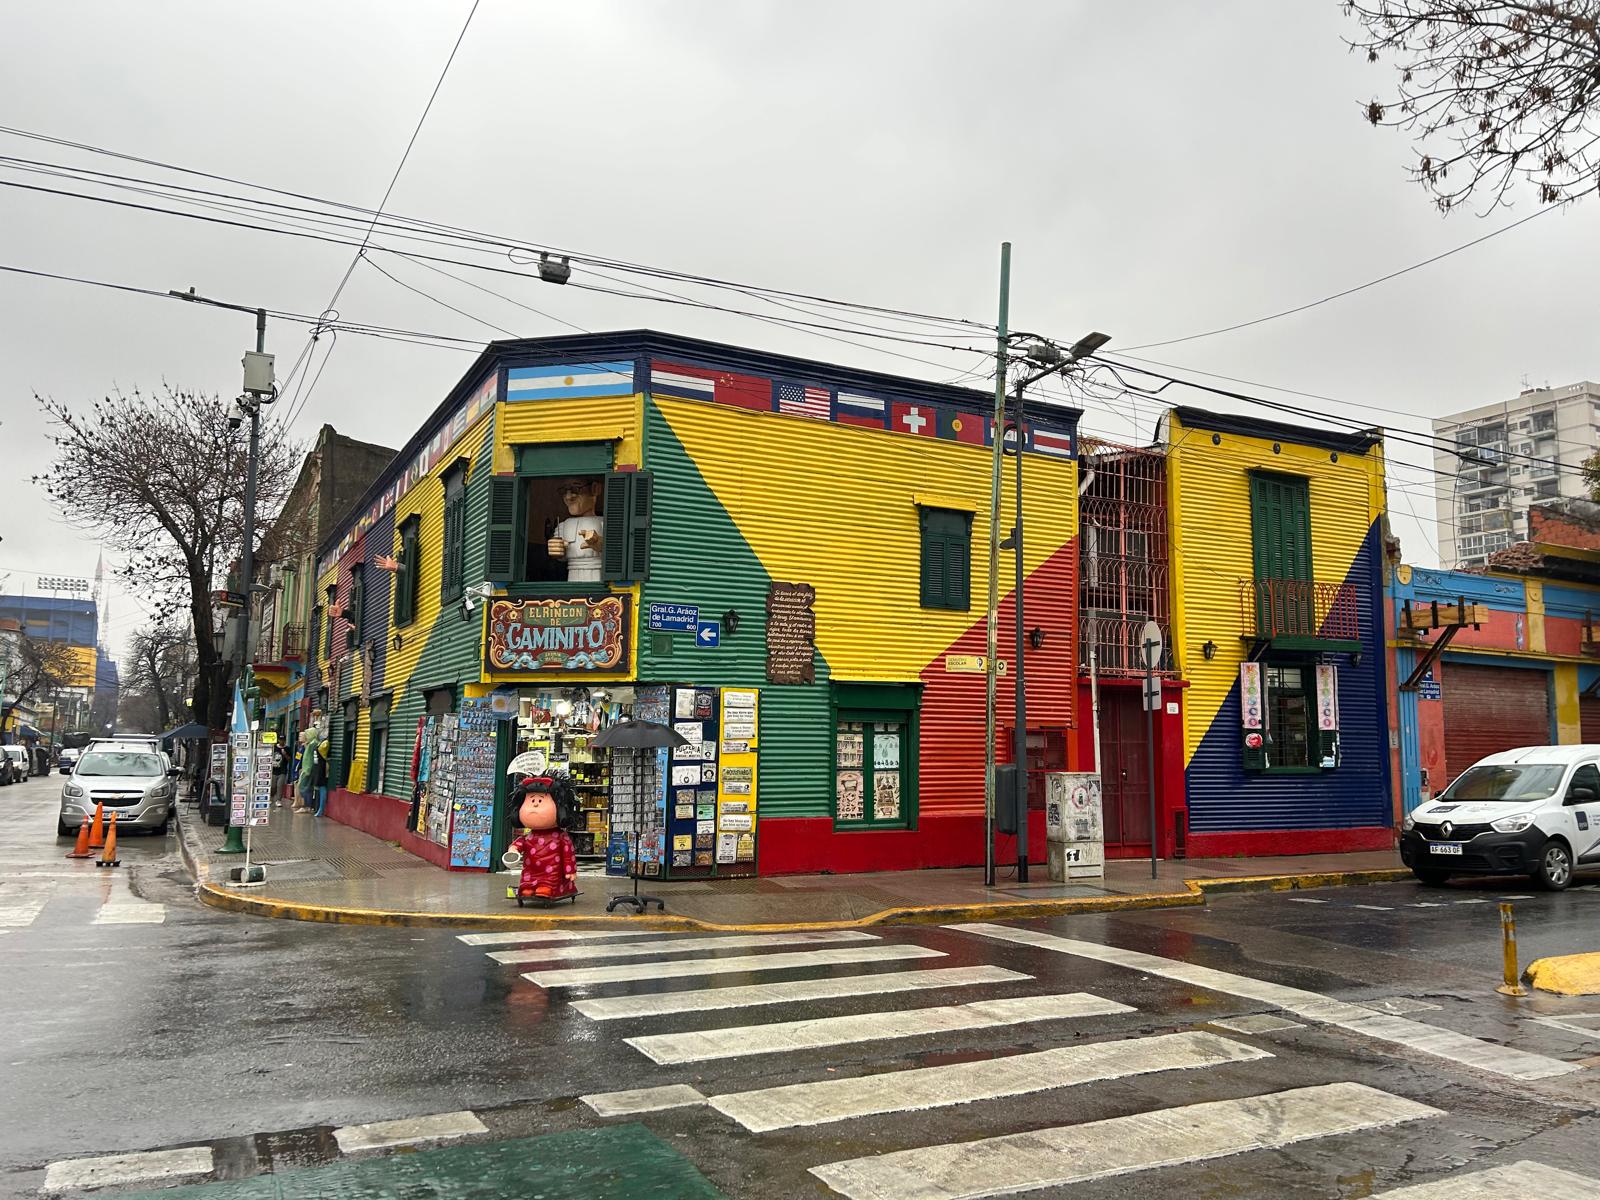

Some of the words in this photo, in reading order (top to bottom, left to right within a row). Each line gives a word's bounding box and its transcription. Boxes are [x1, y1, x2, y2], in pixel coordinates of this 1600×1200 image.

[529, 607, 542, 618] EL
[542, 606, 583, 618] RINCON
[676, 606, 697, 616] Aráoz
[550, 618, 561, 626] DE
[651, 613, 661, 621] de
[661, 614, 694, 623] Lamadrid
[506, 620, 605, 650] CAMINITO
[1247, 665, 1258, 726] KIOSCO
[1320, 667, 1331, 727] KIOSCO
